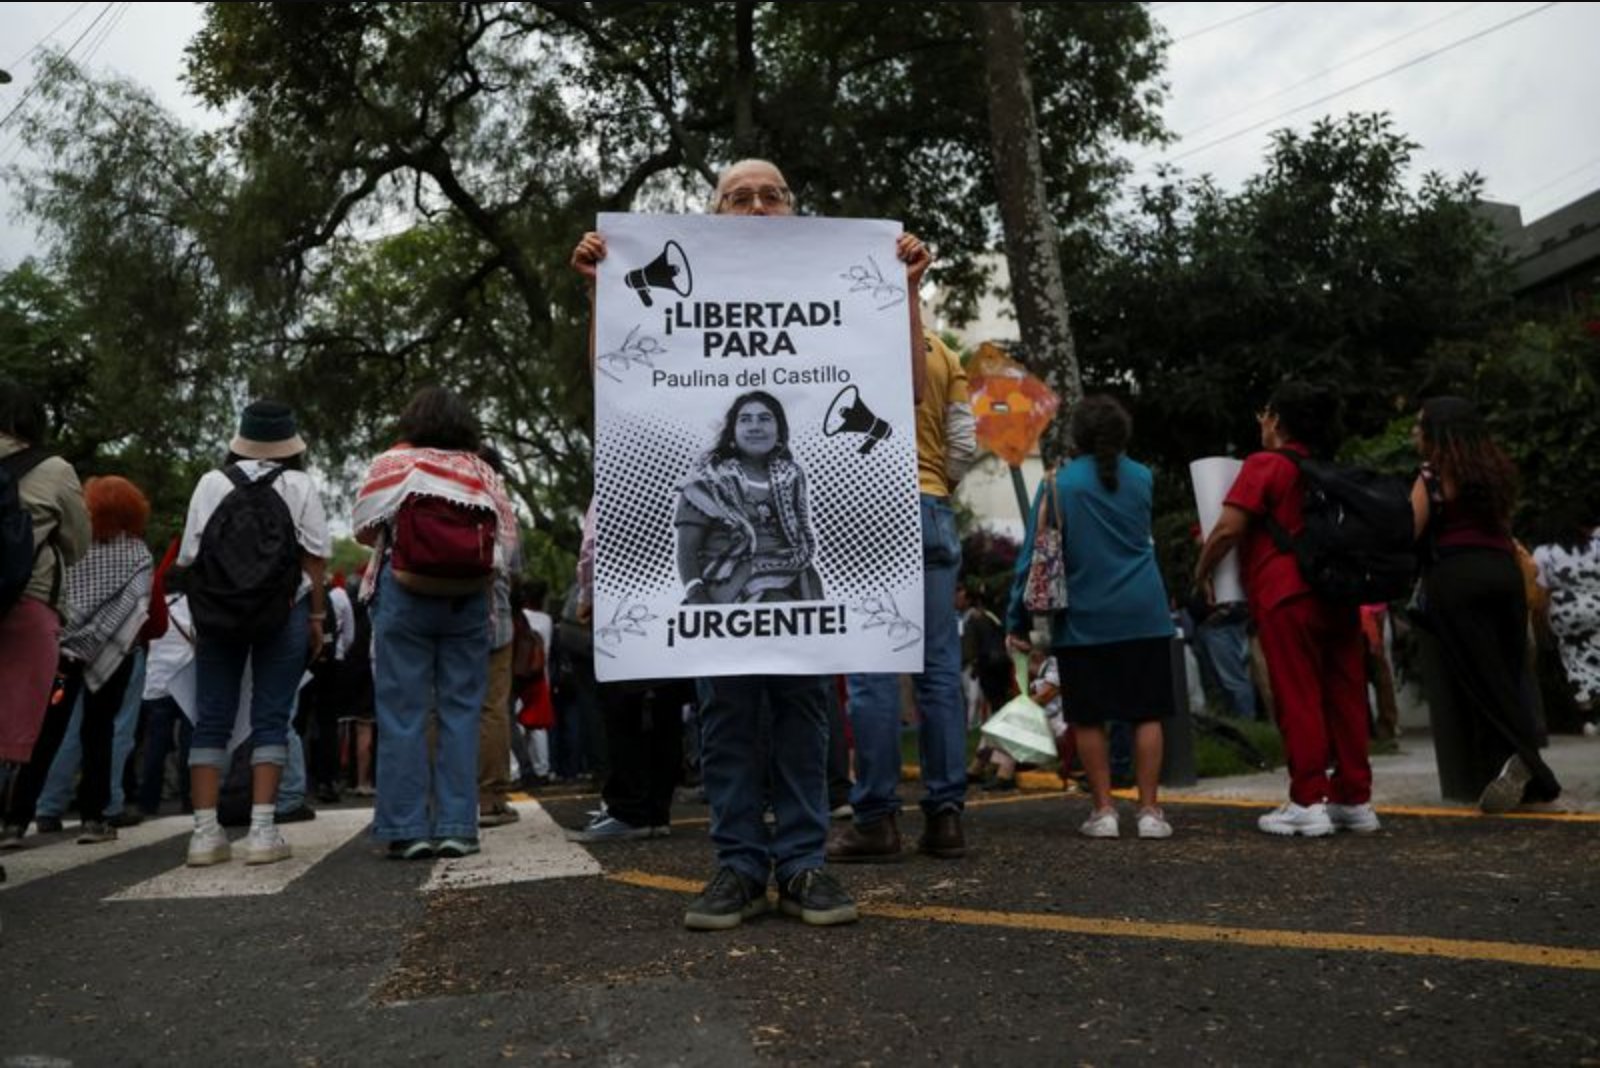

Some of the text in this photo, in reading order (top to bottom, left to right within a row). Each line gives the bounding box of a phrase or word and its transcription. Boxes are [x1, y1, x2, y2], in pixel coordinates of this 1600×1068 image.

[664, 301, 842, 335] ¡LIBERTAD!
[703, 331, 797, 357] PARA
[652, 365, 851, 387] Paulina del Castillo
[667, 604, 847, 647] ¡URGENTE!
